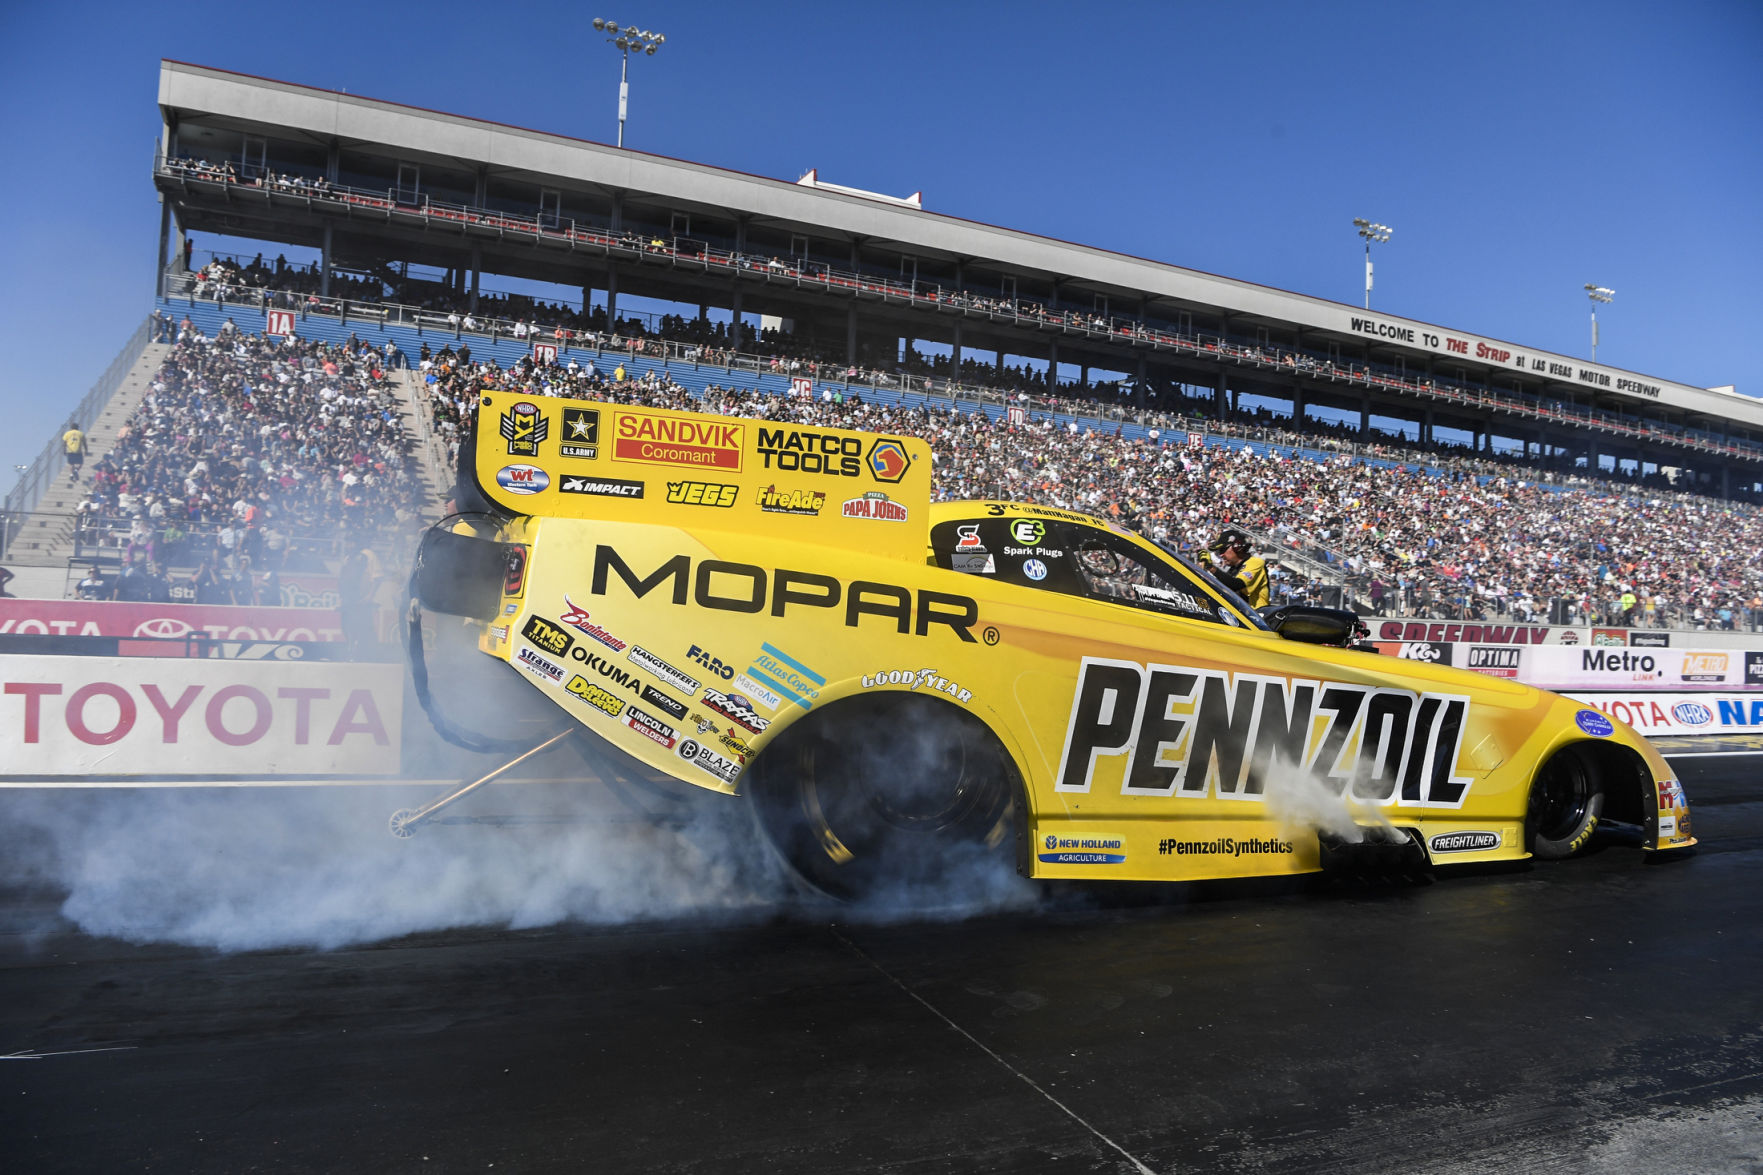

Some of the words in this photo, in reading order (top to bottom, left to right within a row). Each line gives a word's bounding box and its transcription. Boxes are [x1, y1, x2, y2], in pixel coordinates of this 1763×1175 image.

[271, 313, 291, 335] 1A
[1351, 317, 1415, 343] WELCOME
[1422, 333, 1439, 348] TO
[1446, 337, 1468, 355] THE
[1532, 358, 1546, 372] LAS
[1550, 362, 1572, 378] VEGAS
[1579, 369, 1611, 387] MOTOR
[1617, 378, 1661, 398] SPEEDWAY
[618, 416, 740, 449] SANDVIK
[758, 428, 862, 458] MATCO
[641, 443, 716, 465] Coromant
[756, 448, 860, 477] TOOLS
[671, 482, 739, 508] JEGS
[756, 486, 824, 510] FireAde
[843, 500, 871, 518] PAPA
[1003, 546, 1033, 558] Spark
[1036, 547, 1064, 559] Plugs
[591, 544, 980, 643] MOPAR
[528, 632, 561, 654] TITANIUM
[532, 621, 569, 650] TMS
[519, 648, 565, 678] Strange
[571, 646, 641, 695] OKUMA
[686, 645, 735, 680] FARO
[1470, 649, 1519, 667] OPTIMA
[753, 655, 788, 680] Atlas
[787, 673, 820, 699] Copco
[566, 675, 625, 709] DARTON
[648, 688, 682, 710] TREND
[4, 681, 391, 747] TOYOTA
[628, 707, 672, 737] LINCOLN
[704, 688, 770, 730] TRAXXAS
[1675, 703, 1711, 724] NHRA
[633, 721, 670, 746] WELDERS
[1057, 657, 1473, 807] PENNZOIL
[719, 735, 754, 758] SUNOCO
[699, 747, 740, 777] BLAZE
[1059, 839, 1080, 849] NEW
[1081, 839, 1121, 849] HOLLAND
[1159, 838, 1295, 858] #PennzoilSynthetics
[1434, 834, 1495, 849] FREIGHTLINER
[1058, 854, 1107, 862] AGRICULTURE
